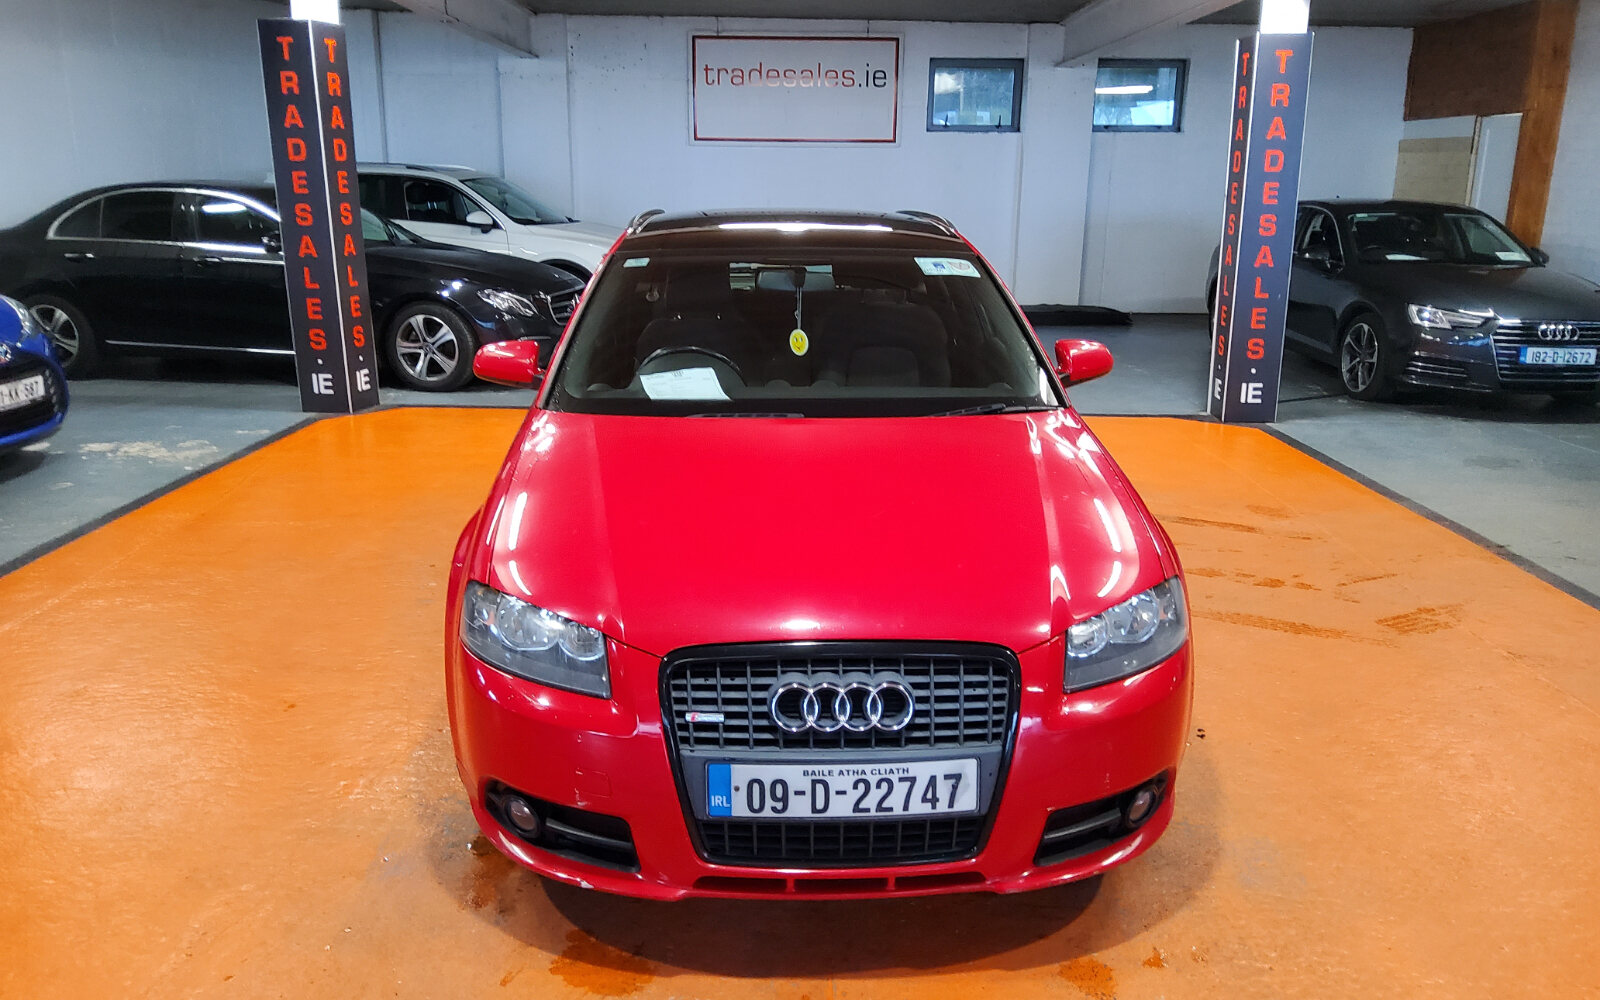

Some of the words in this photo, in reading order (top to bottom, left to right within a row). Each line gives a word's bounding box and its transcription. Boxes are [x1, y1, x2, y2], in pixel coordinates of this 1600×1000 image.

[703, 62, 888, 88] tradesales.ie
[276, 36, 335, 395] TRADESALES.IE
[324, 37, 372, 392] TRADESALES.IE
[1239, 49, 1294, 404] TRADESALES.IE
[746, 773, 963, 815] 09-D-22747
[802, 769, 834, 777] BAILE
[711, 795, 731, 808] IRL
